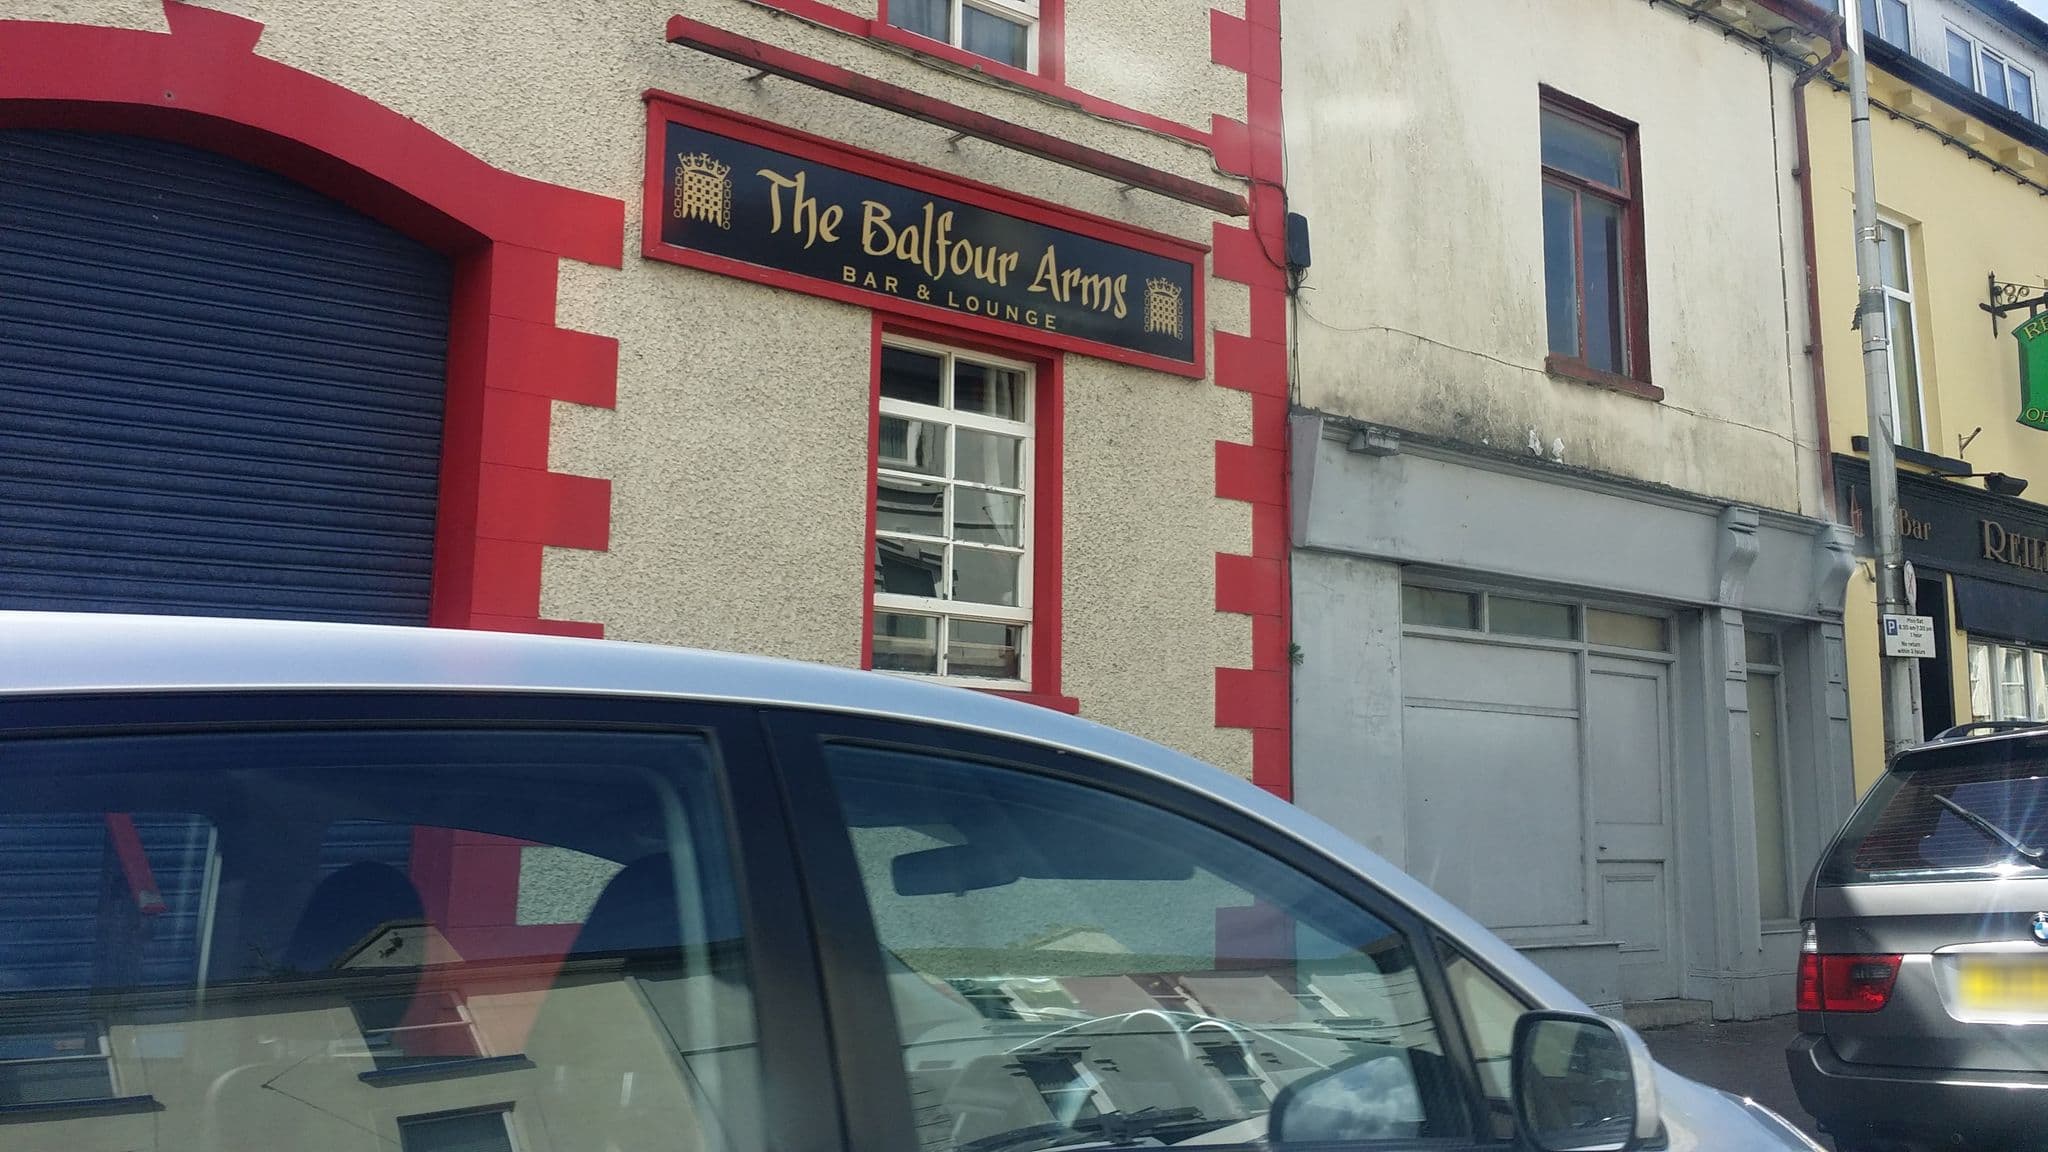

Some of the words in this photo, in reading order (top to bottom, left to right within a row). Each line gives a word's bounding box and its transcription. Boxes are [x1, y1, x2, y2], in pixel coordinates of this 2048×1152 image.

[756, 168, 843, 249] The
[861, 200, 1018, 287] Balfour
[1027, 244, 1128, 319] Arms
[842, 265, 898, 293] BAR
[917, 284, 930, 300] &
[948, 291, 1056, 329] LOUNGE
[1900, 508, 1932, 541] Bar
[1887, 620, 1895, 634] P
